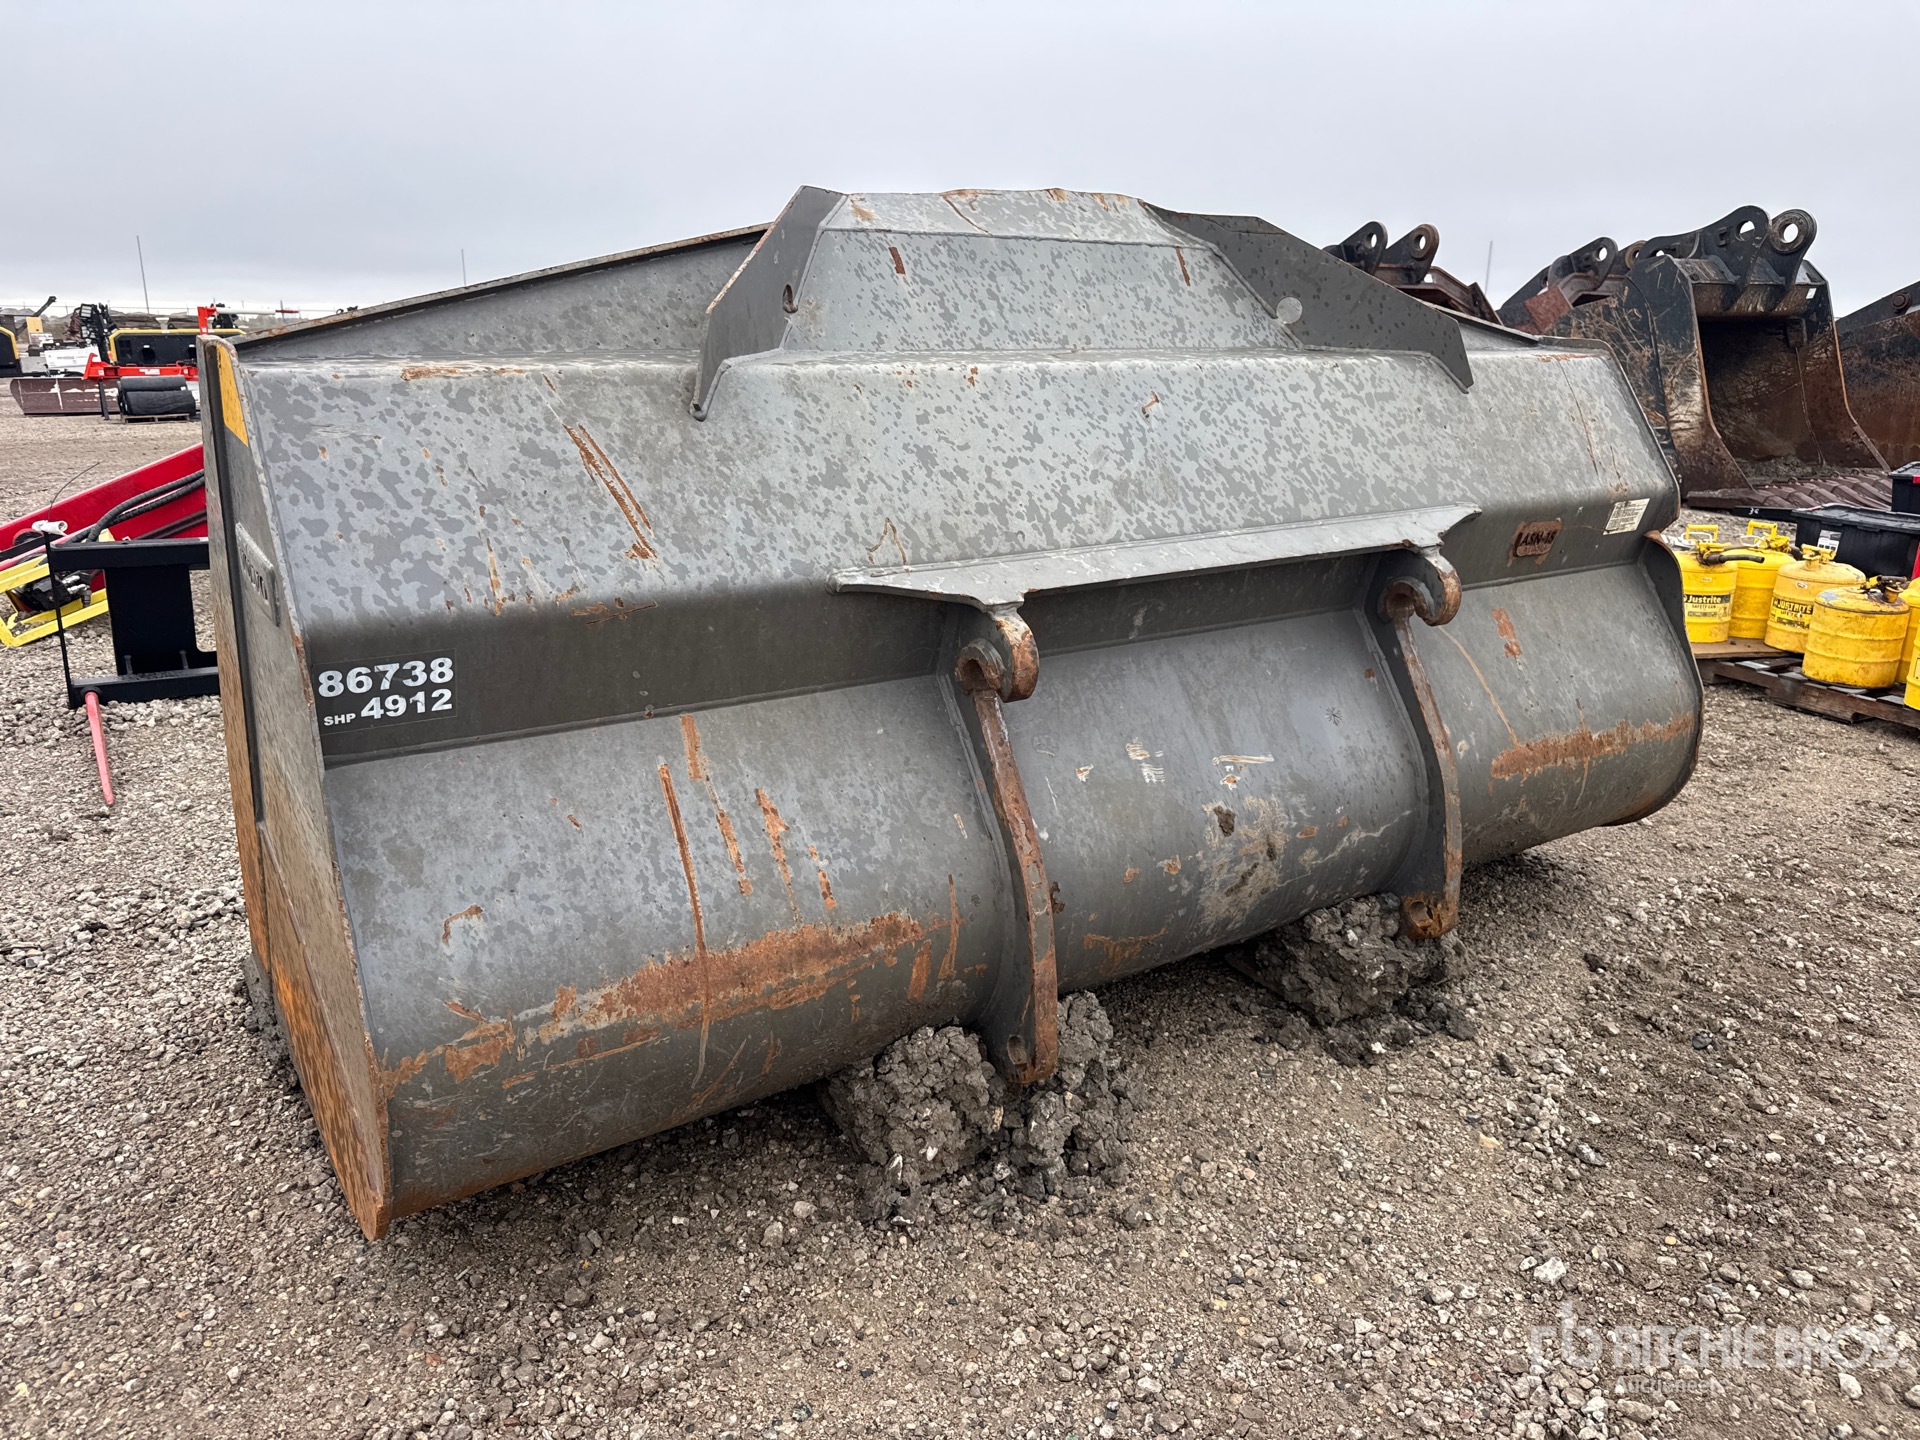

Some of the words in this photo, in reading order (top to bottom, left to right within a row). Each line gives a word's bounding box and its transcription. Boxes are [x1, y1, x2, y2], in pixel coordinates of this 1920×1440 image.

[1687, 595, 1722, 604] Justrite
[1778, 599, 1812, 614] JUSTRITE
[318, 657, 454, 697] 86738
[323, 712, 356, 726] SHP
[360, 688, 453, 719] 4912
